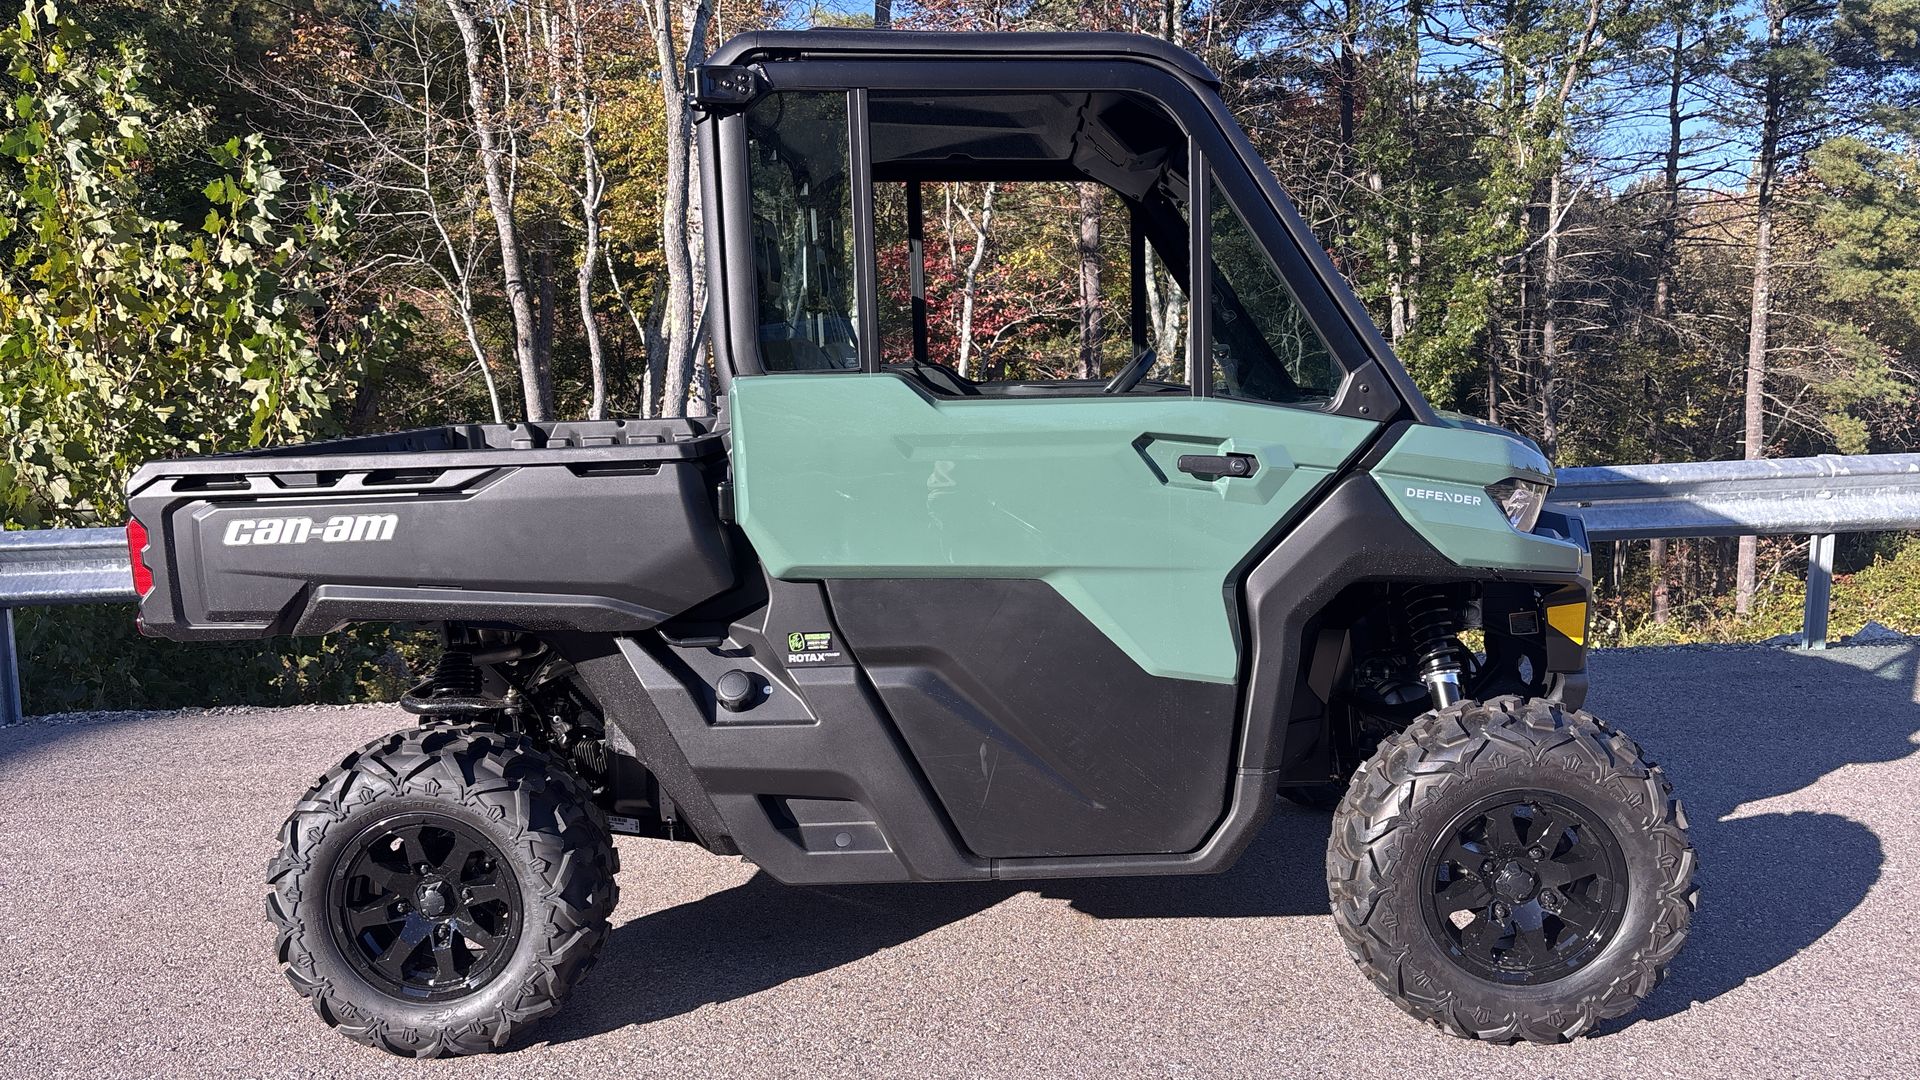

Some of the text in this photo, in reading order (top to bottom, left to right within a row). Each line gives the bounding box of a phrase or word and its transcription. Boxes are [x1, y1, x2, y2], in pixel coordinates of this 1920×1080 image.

[1406, 487, 1482, 506] DEFENDER
[223, 514, 399, 546] can-am
[788, 653, 825, 663] ROTAX
